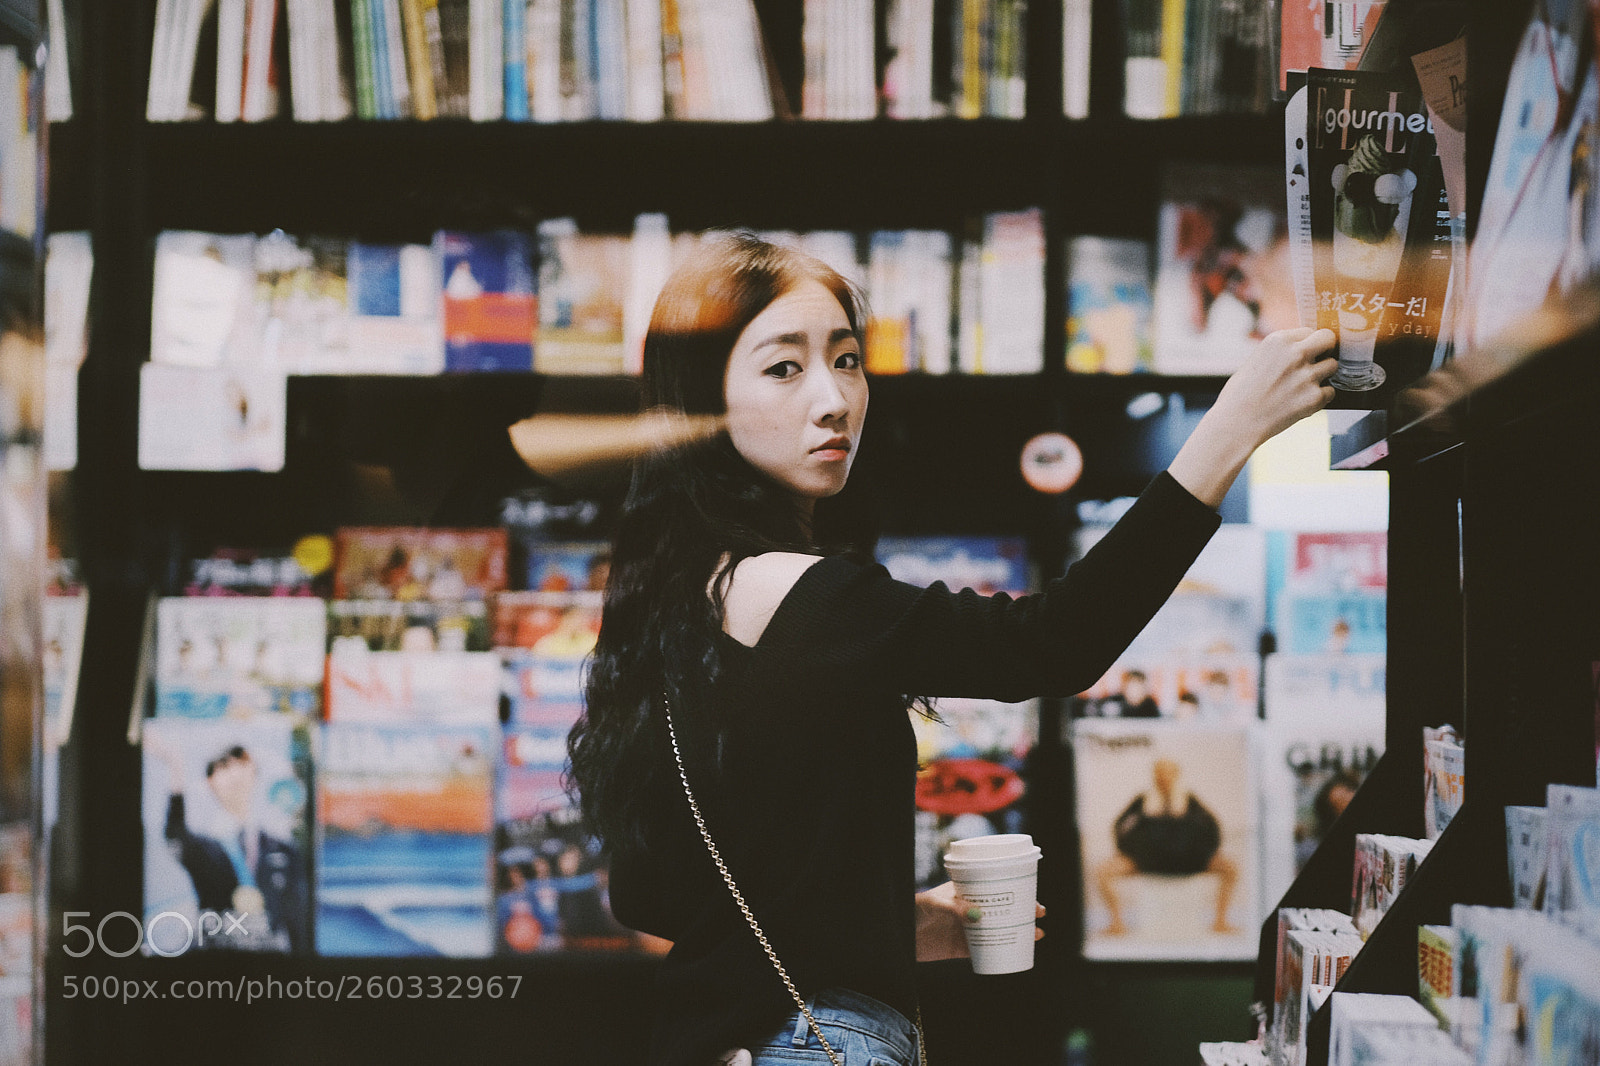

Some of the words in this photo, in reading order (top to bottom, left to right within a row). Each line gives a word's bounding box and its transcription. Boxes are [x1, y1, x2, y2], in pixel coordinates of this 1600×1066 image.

[1315, 87, 1407, 154] ELL
[1317, 290, 1428, 317] 茶がスターだ!
